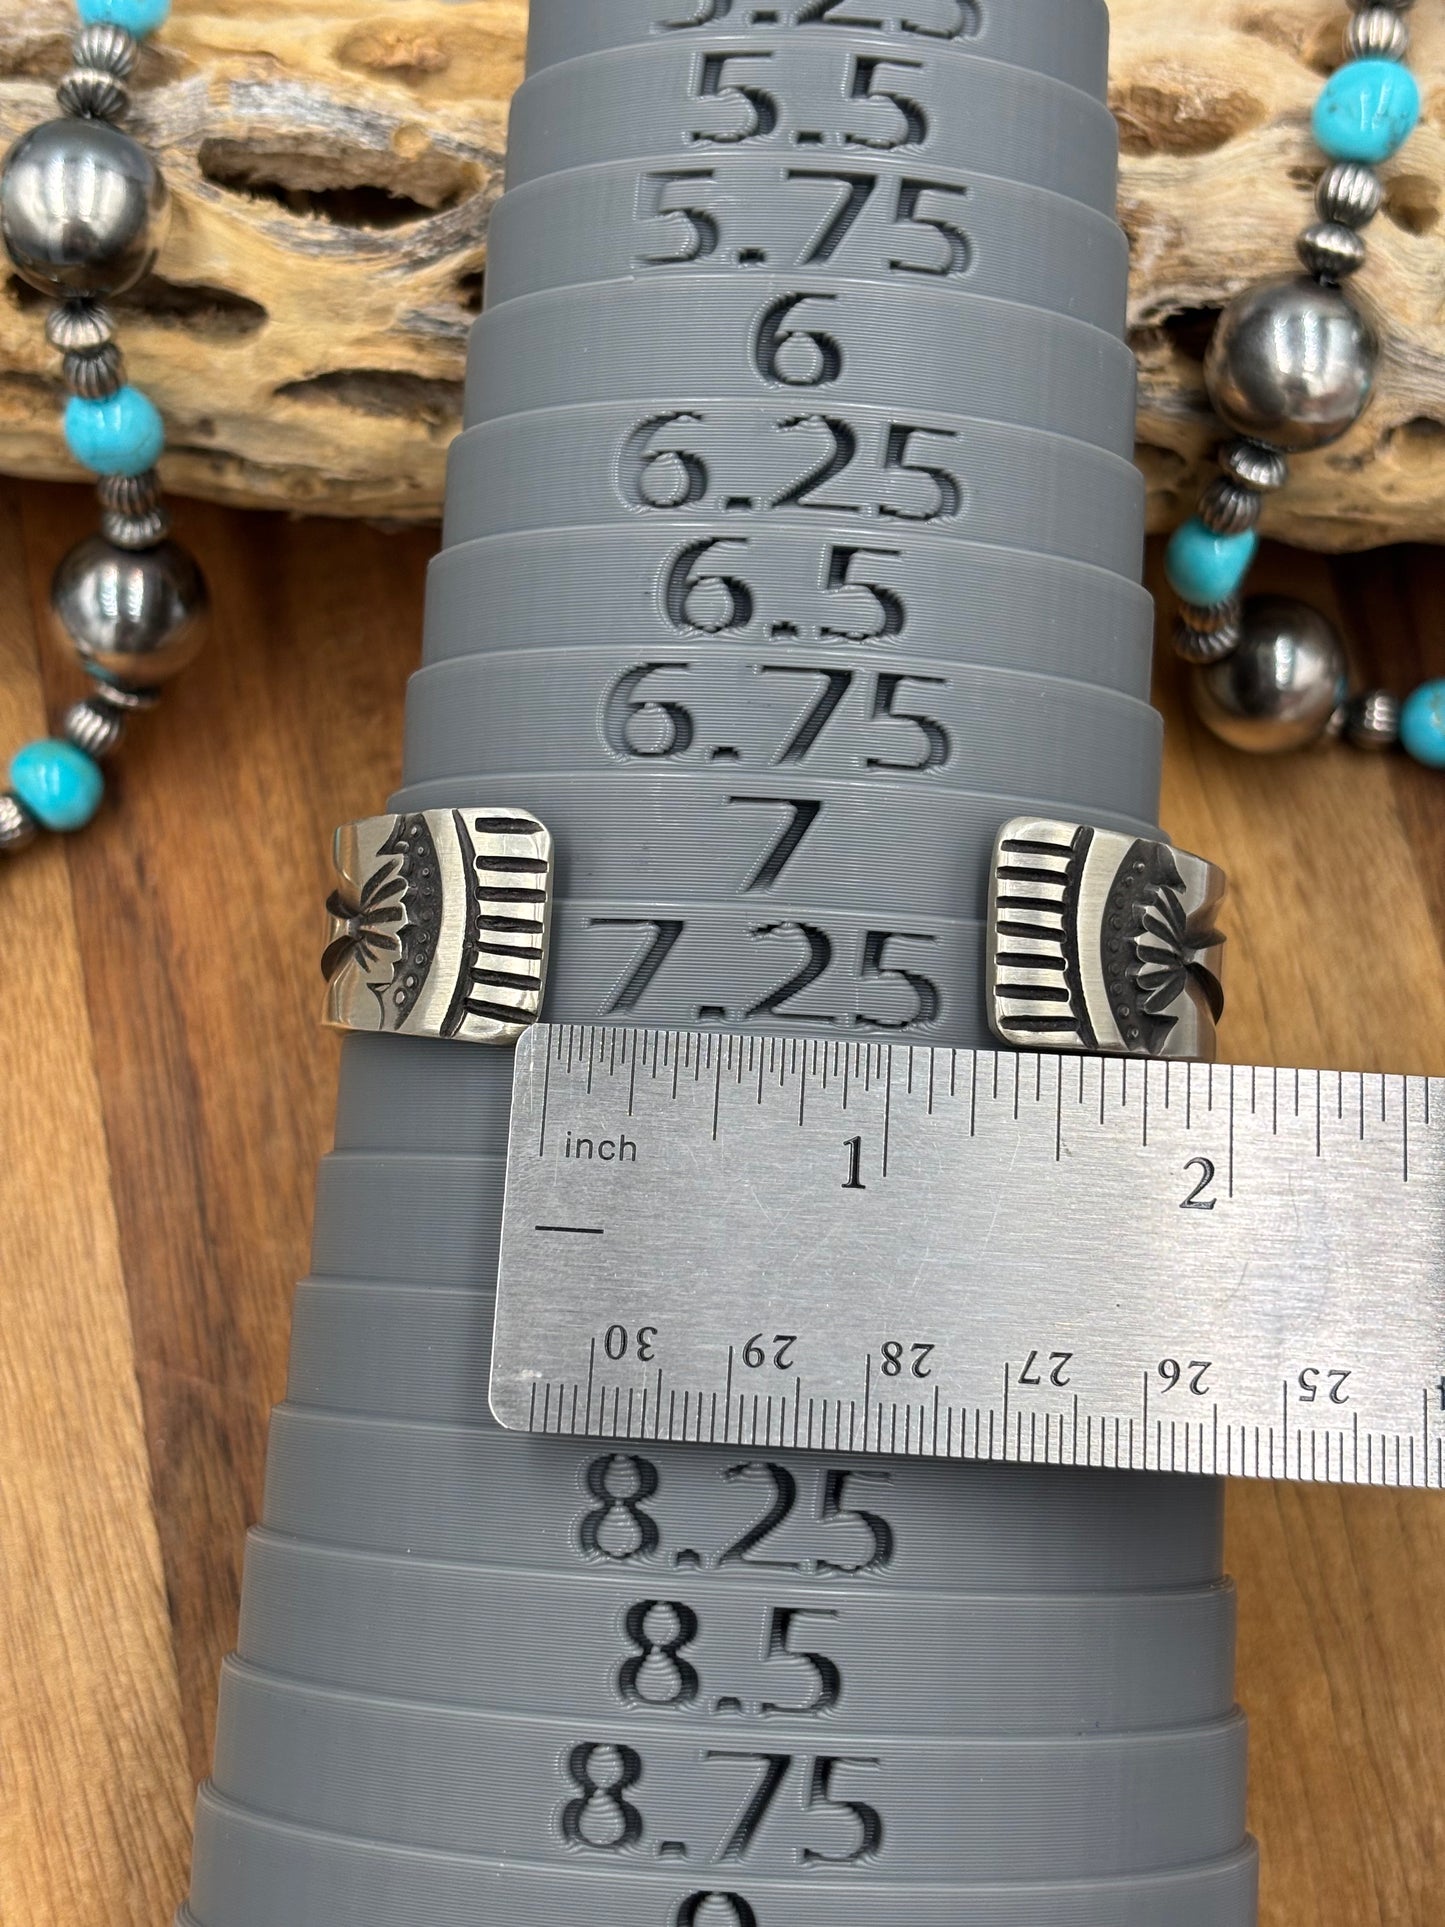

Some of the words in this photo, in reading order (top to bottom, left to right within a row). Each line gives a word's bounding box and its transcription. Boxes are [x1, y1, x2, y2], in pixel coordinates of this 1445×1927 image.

[683, 50, 934, 150] 5.5
[630, 168, 978, 277] 5.75
[748, 291, 843, 389] 6
[611, 411, 967, 524] 6.25
[654, 536, 906, 645] 6.5
[596, 661, 954, 772] 6.75
[723, 796, 824, 895] 7
[583, 918, 946, 1032] 7.25
[565, 1131, 637, 1162] inch
[841, 1136, 866, 1189] 1
[1179, 1156, 1217, 1210] 2
[604, 1324, 658, 1361] 30
[742, 1333, 797, 1369] 29
[881, 1342, 935, 1379] 28
[1018, 1351, 1073, 1387] 27
[1158, 1359, 1212, 1395] 26
[1299, 1368, 1351, 1404] 25
[570, 1453, 895, 1575] 8.25
[605, 1599, 841, 1716] 8.5
[551, 1741, 882, 1864] 8.75
